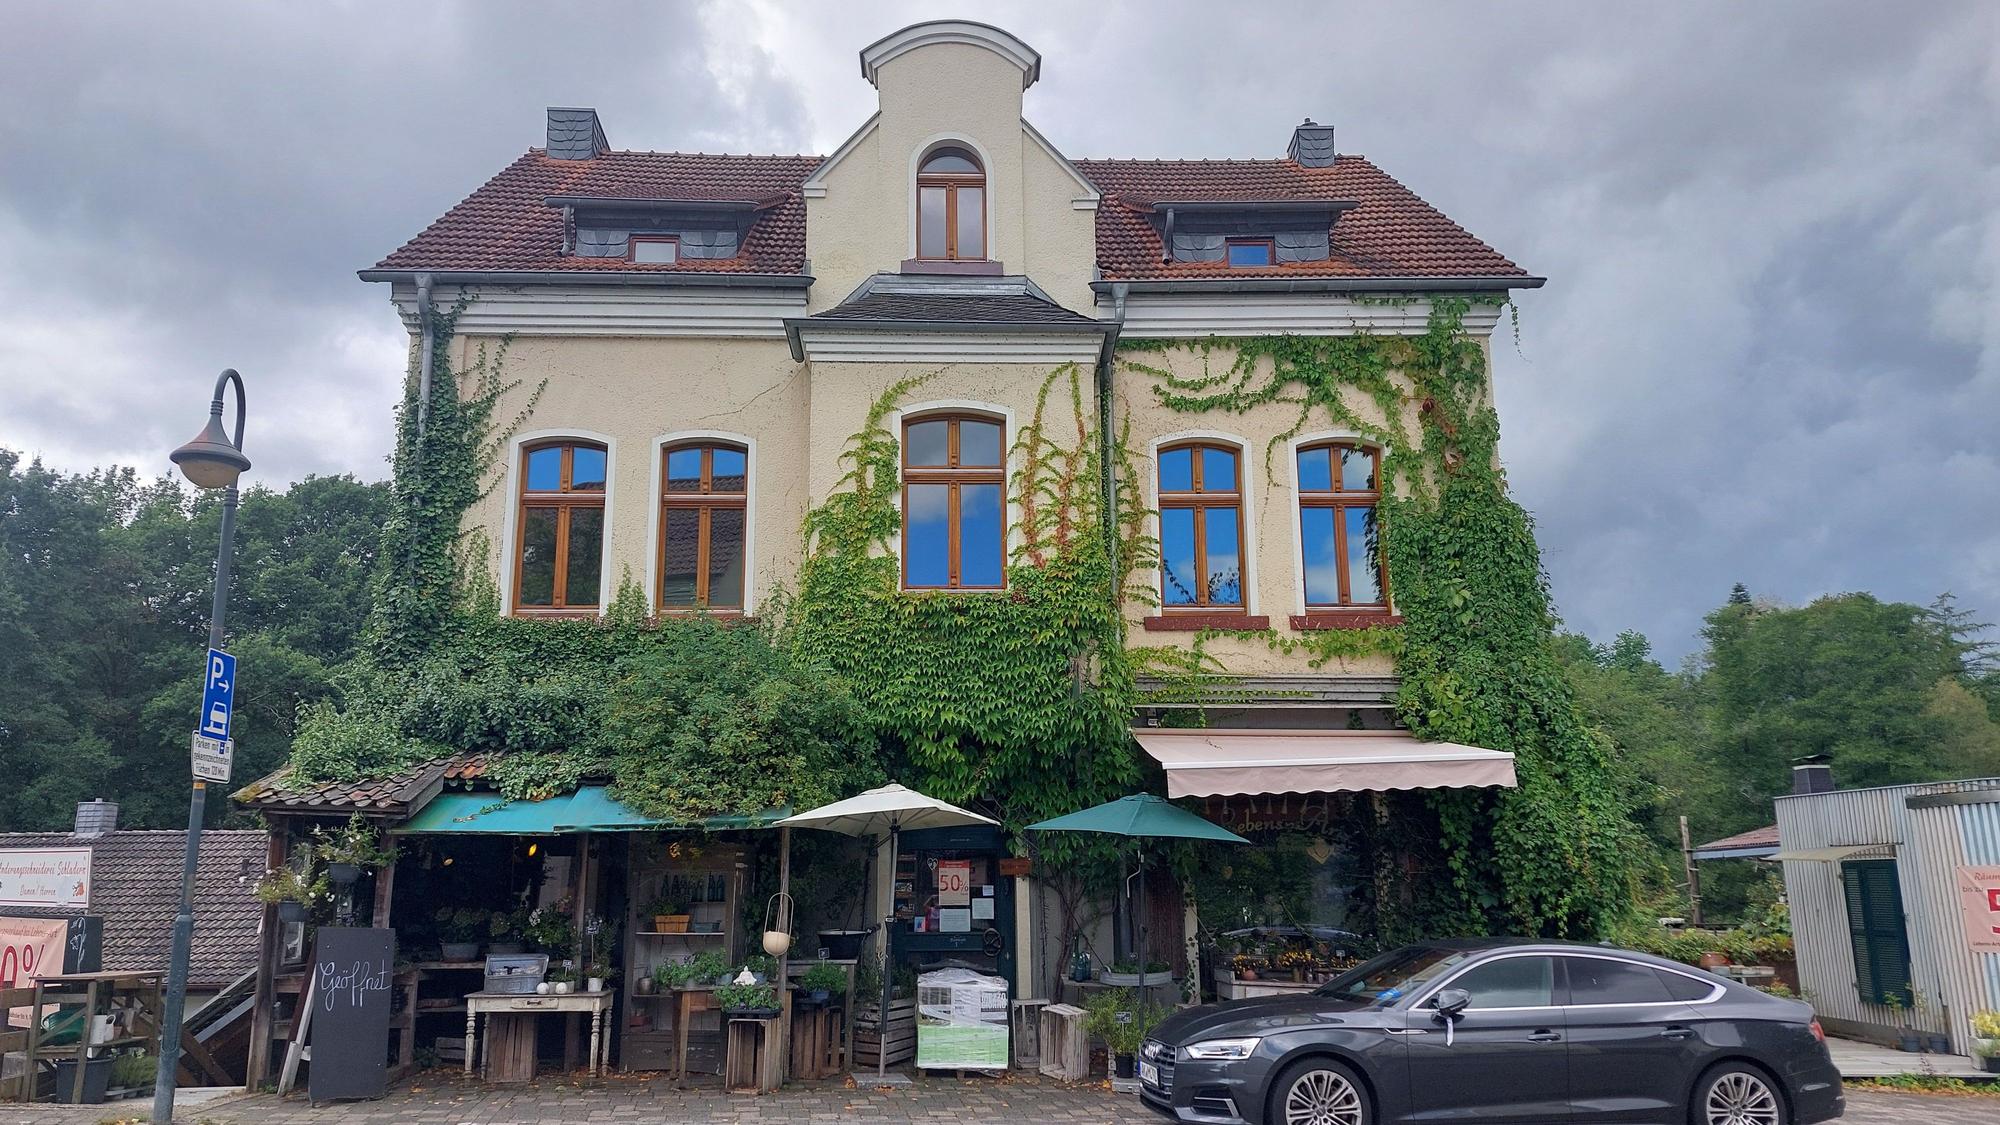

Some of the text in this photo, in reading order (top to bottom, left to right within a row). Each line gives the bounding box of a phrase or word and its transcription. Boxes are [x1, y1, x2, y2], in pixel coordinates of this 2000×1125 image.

[210, 656, 224, 690] P
[940, 874, 968, 892] 50%
[320, 960, 392, 1012] Geöffnet
